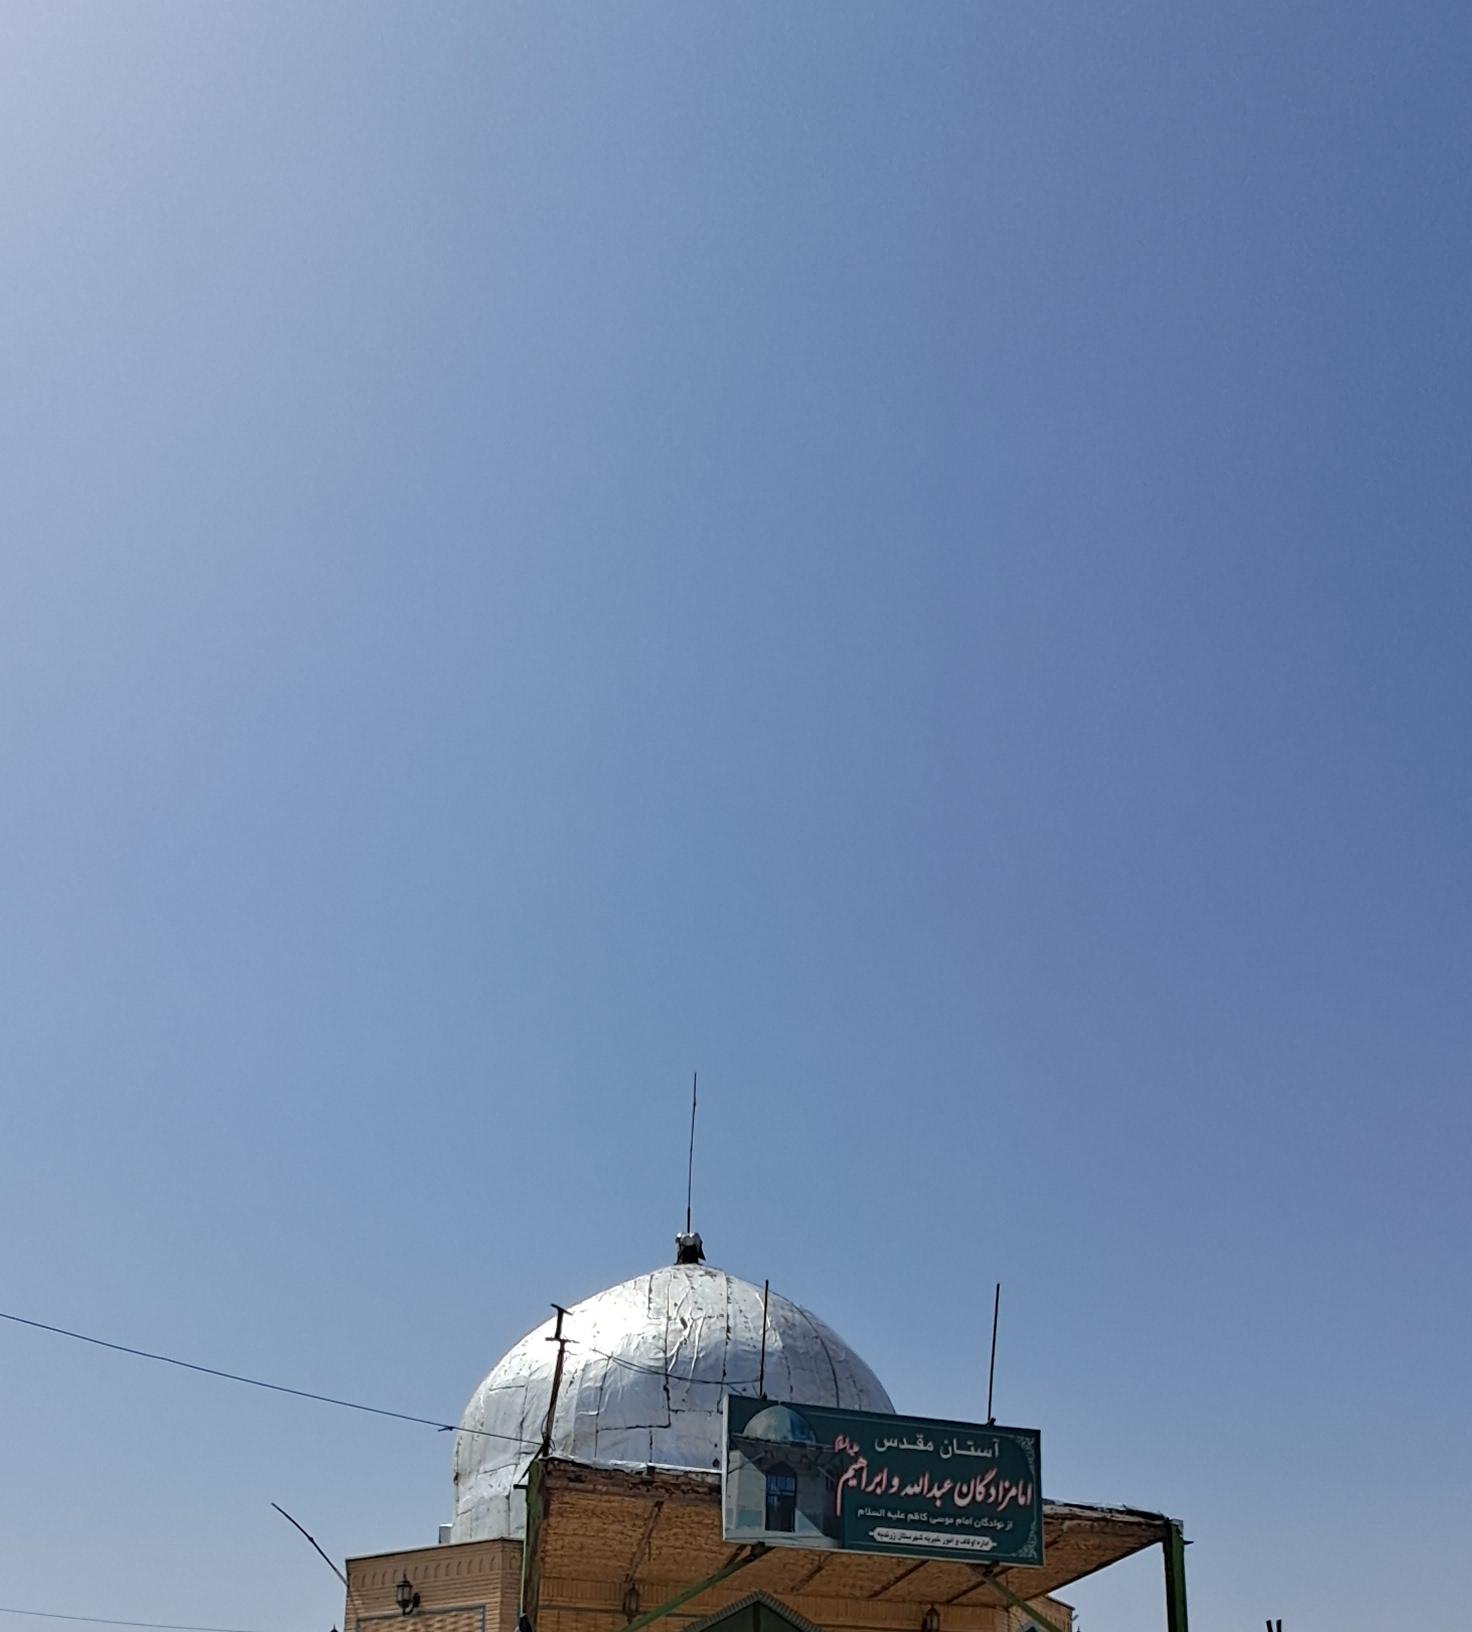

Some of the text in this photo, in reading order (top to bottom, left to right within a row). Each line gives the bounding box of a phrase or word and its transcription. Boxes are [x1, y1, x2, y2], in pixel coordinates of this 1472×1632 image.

[874, 1432, 1000, 1459] آستان مقدس
[836, 1456, 1032, 1517] امامزادگان عبدالله و ابراهیم
[857, 1507, 1014, 1531] از نوادگان امام موسی کاظم علیه السلام
